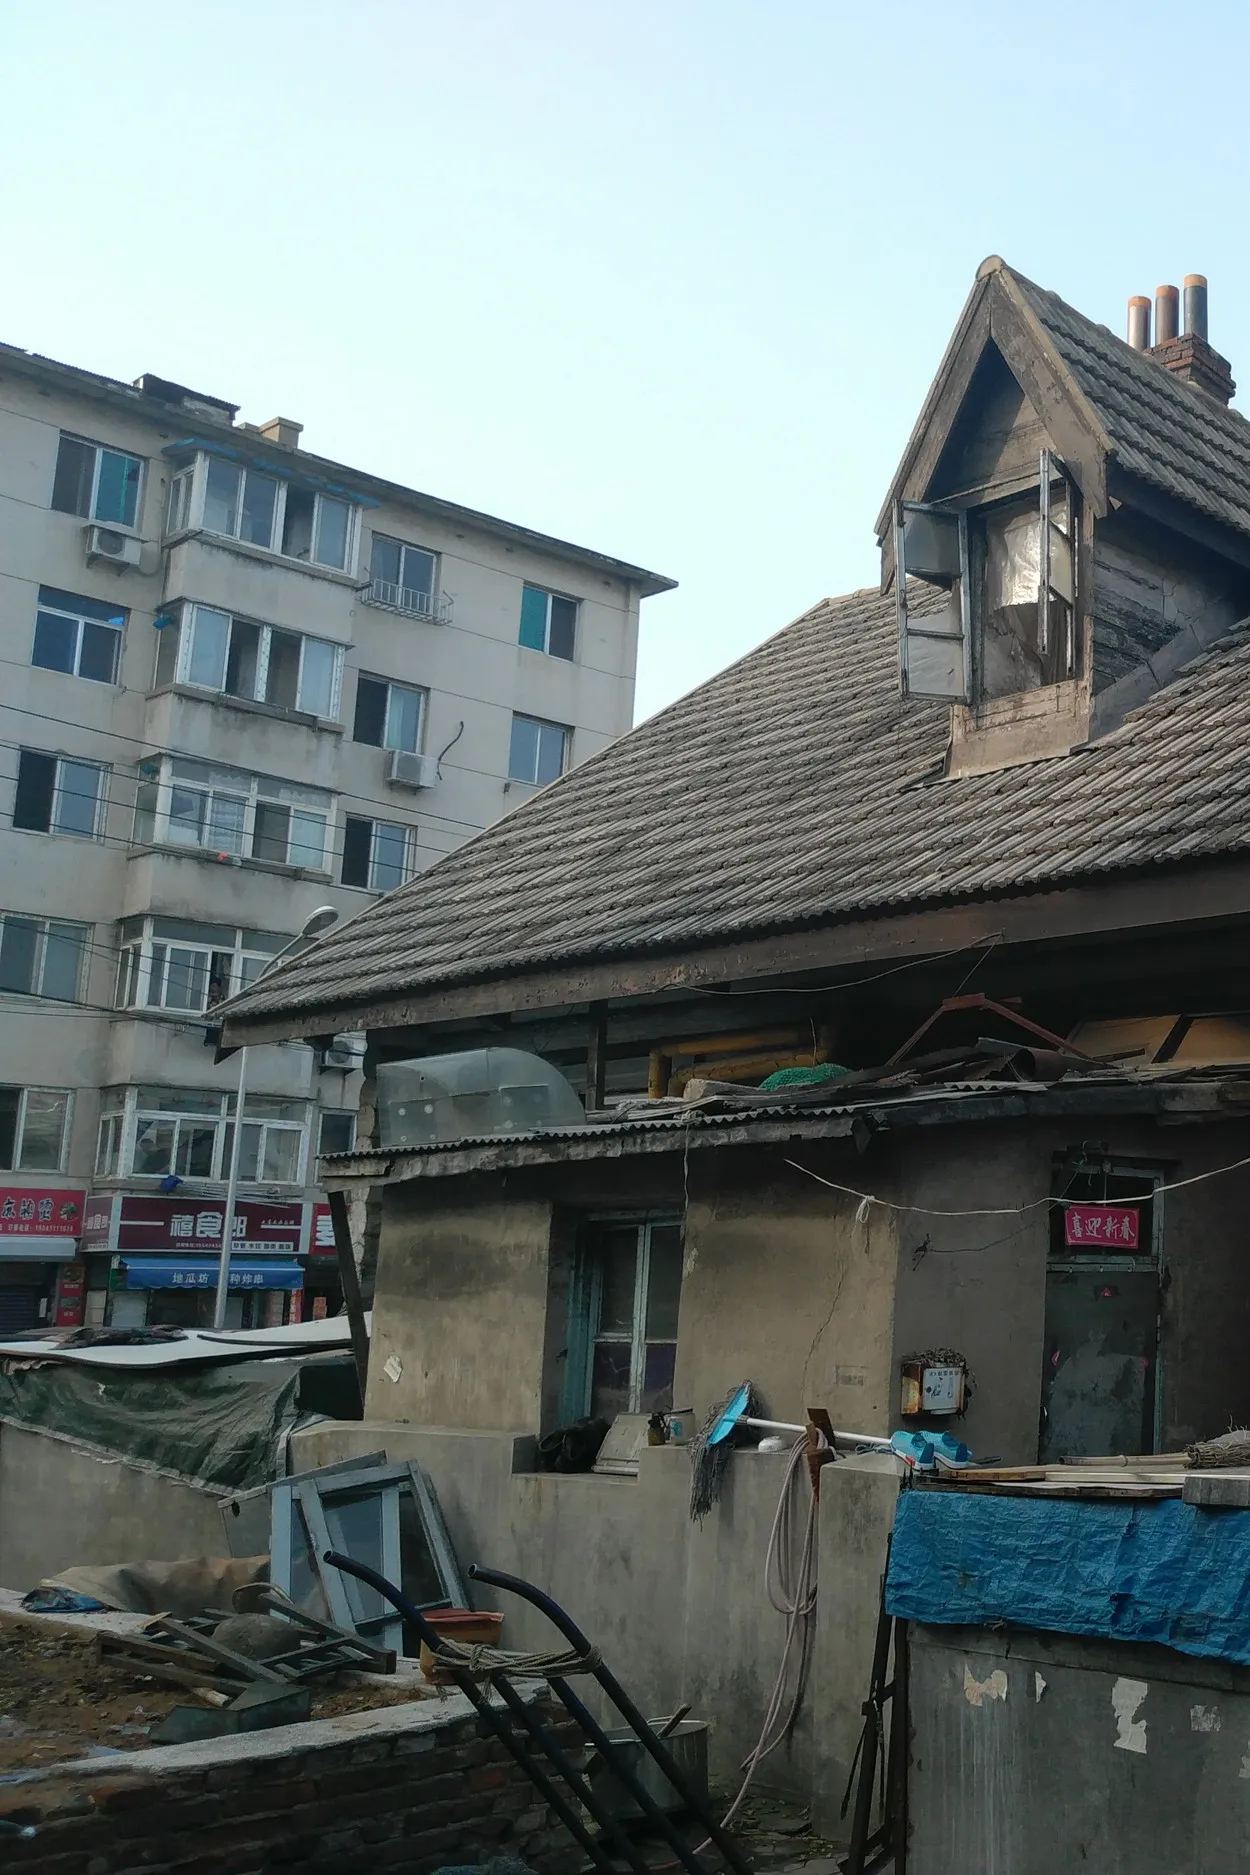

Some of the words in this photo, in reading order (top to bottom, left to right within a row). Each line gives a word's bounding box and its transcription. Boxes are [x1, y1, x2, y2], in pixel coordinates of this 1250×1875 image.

[1071, 1211, 1135, 1241] 喜迎新春
[172, 1271, 210, 1284] 地瓜坊
